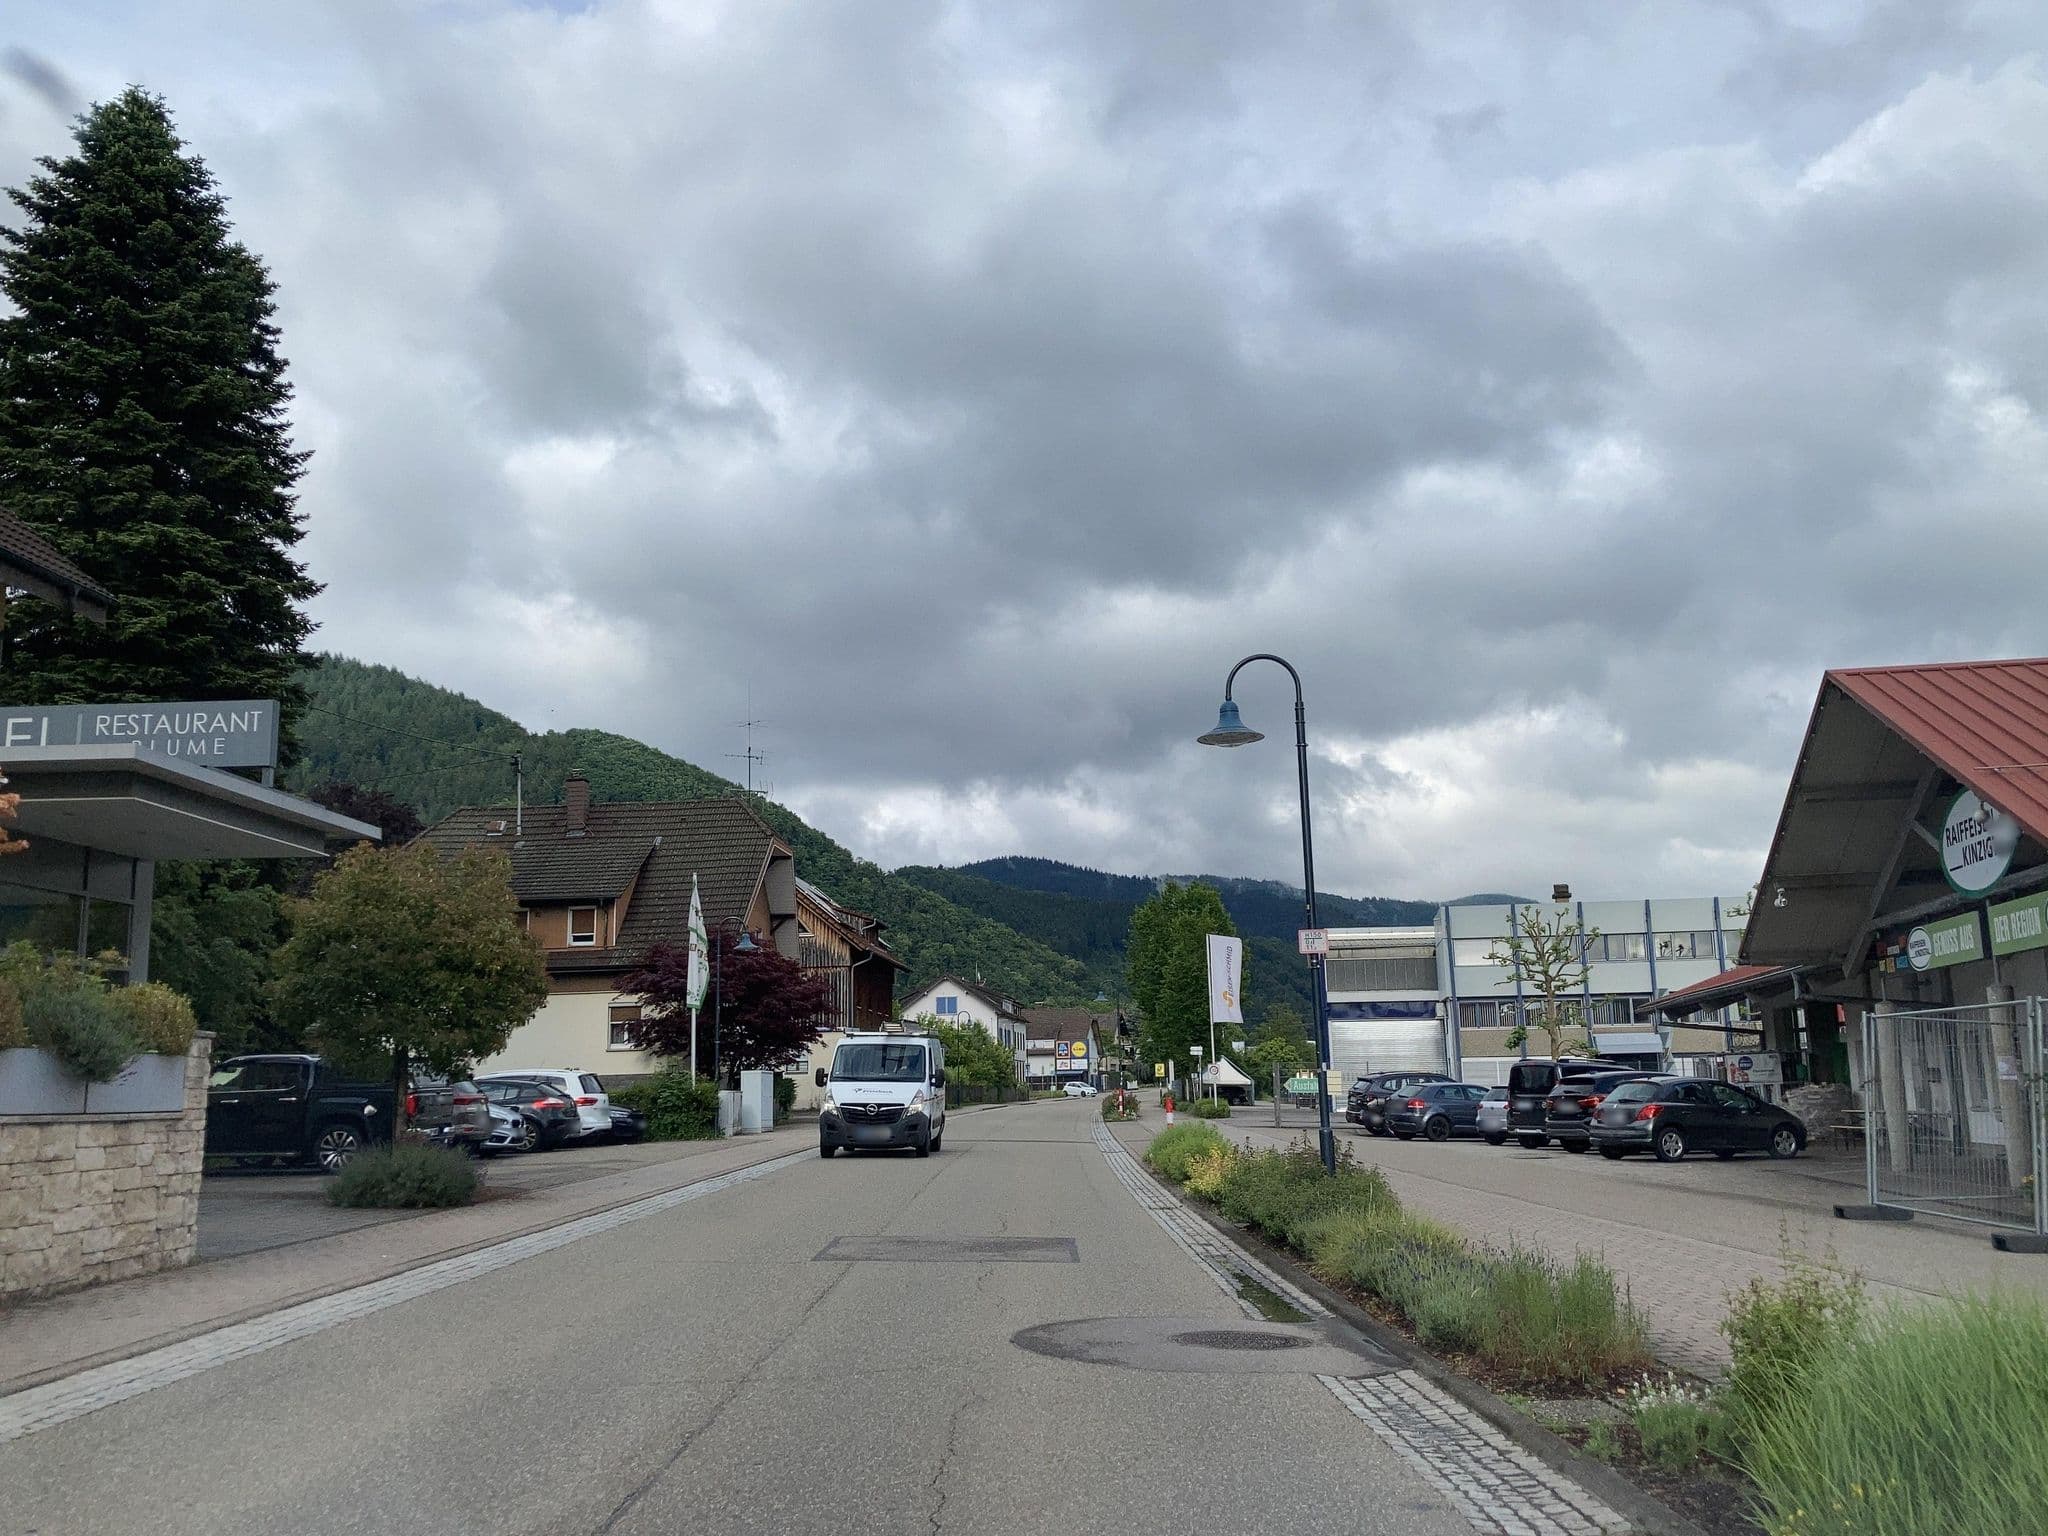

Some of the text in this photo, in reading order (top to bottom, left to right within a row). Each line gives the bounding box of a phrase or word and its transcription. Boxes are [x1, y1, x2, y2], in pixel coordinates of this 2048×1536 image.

[95, 711, 263, 736] RESTAURANT
[1961, 836, 1998, 867] KINZIG
[1959, 923, 1975, 951] AUS
[1993, 906, 2042, 944] DER REGION
